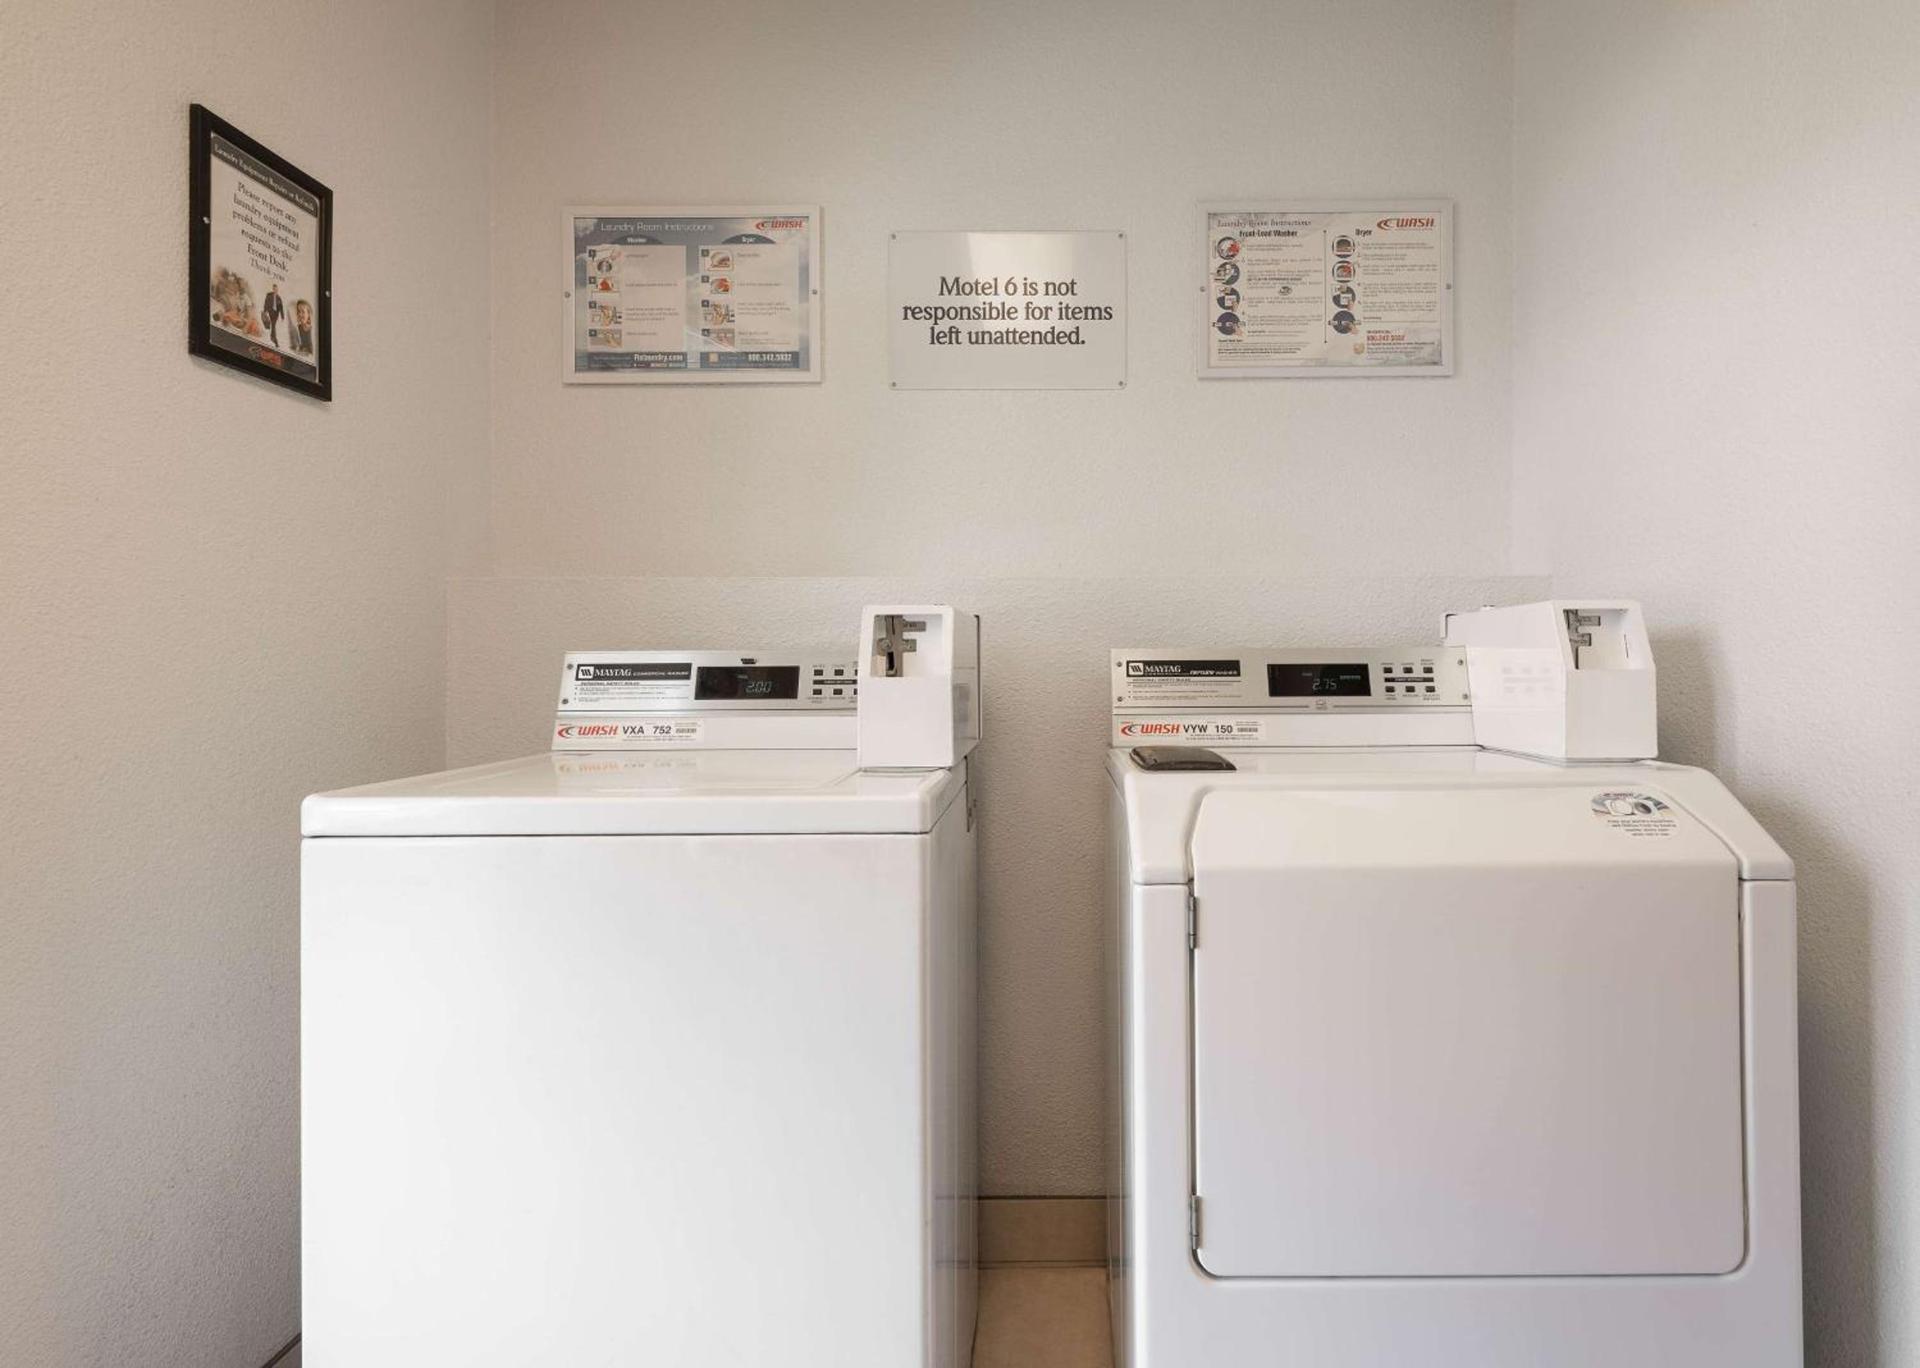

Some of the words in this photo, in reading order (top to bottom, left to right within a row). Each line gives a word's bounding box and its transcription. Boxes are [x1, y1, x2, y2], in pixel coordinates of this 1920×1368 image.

[238, 181, 261, 203] Please
[262, 199, 284, 217] report
[233, 193, 262, 219] laundry
[263, 212, 299, 239] equipment
[1396, 218, 1435, 228] WASH
[232, 210, 267, 234] problems
[268, 230, 277, 239] or
[278, 233, 300, 251] refund
[601, 222, 634, 233] Laundry
[637, 222, 662, 231] Room
[665, 222, 714, 231] Instructions
[771, 220, 803, 229] WASH
[241, 228, 271, 250] requests
[1355, 228, 1372, 237] Dryer
[247, 243, 268, 263] Front
[938, 276, 1000, 296] Motel
[1004, 277, 1018, 296] 6
[1022, 277, 1038, 296] is
[1043, 278, 1077, 296] not
[902, 302, 1018, 325] responsible
[1024, 302, 1053, 321] for
[1057, 302, 1113, 321] items
[929, 326, 962, 345] left
[967, 326, 1086, 345] unattended.
[594, 668, 632, 677] MAYTAG
[1144, 665, 1181, 673] MAYTAG
[578, 725, 618, 736] WASH
[622, 726, 645, 735] VXA
[652, 726, 672, 735] 752
[1140, 724, 1180, 734] WASH
[1183, 725, 1208, 734] VYW
[1215, 725, 1233, 734] 150
